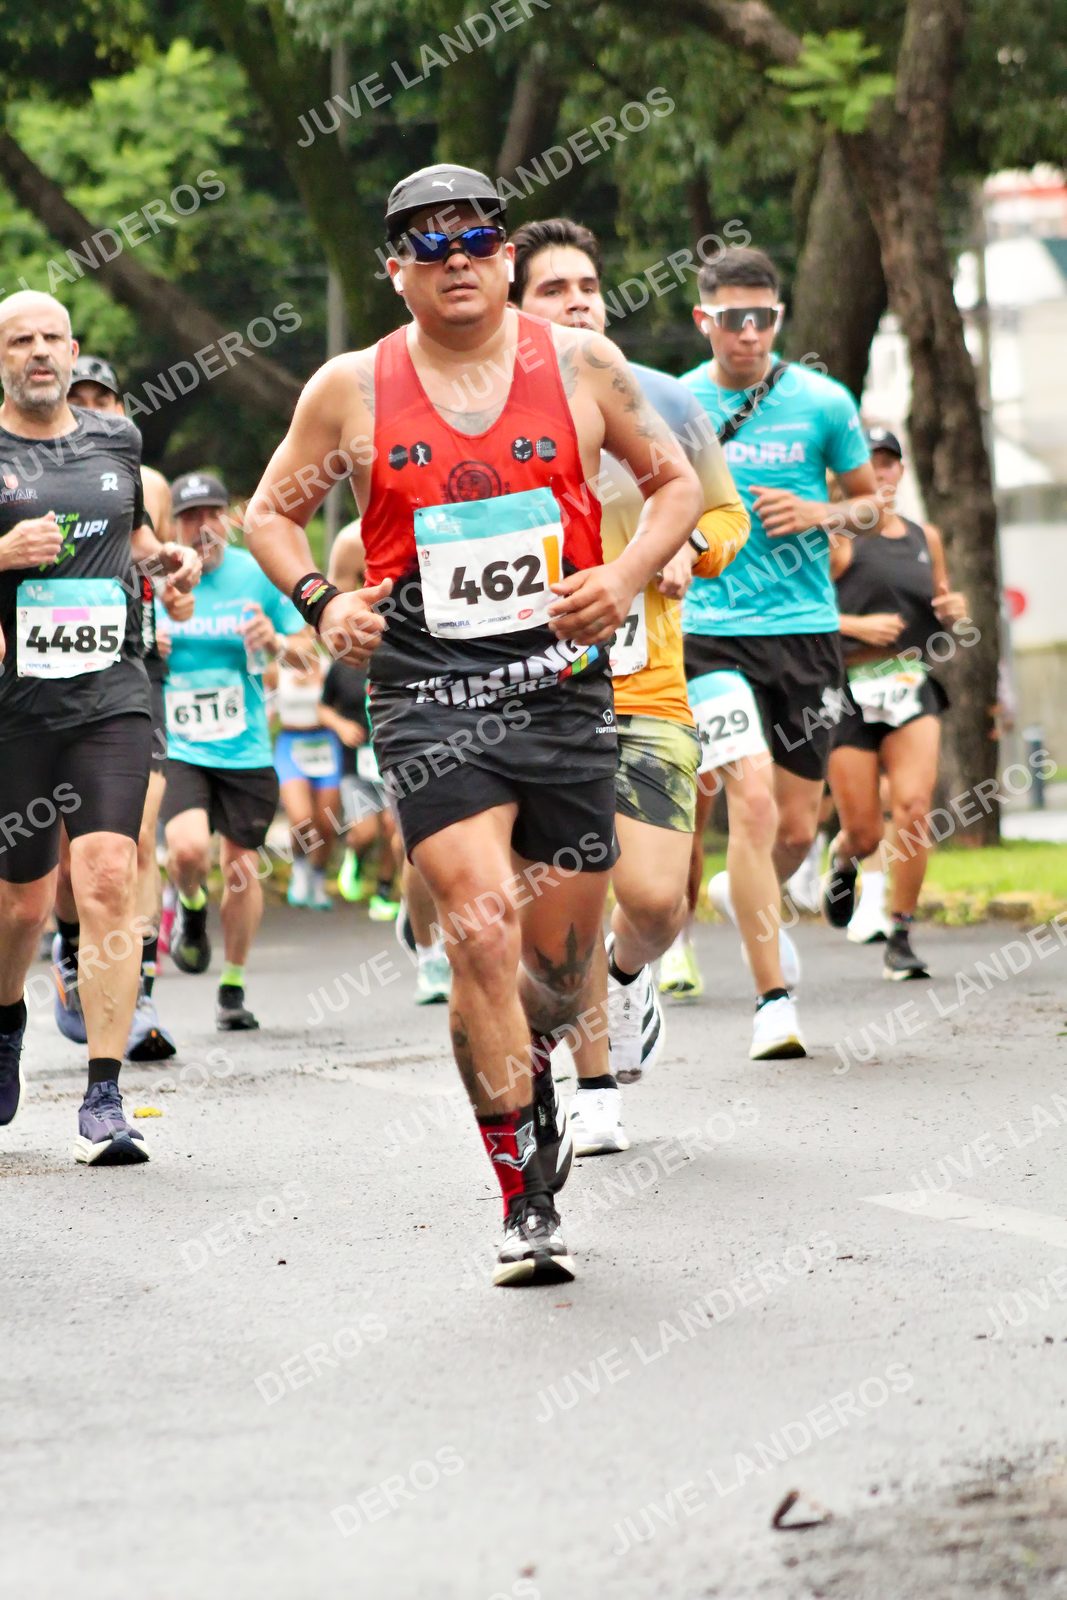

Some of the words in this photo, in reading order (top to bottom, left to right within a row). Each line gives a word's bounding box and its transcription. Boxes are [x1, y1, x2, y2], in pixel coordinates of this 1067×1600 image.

[449, 554, 545, 605] 462
[26, 624, 119, 654] 4485
[174, 697, 239, 725] 6116
